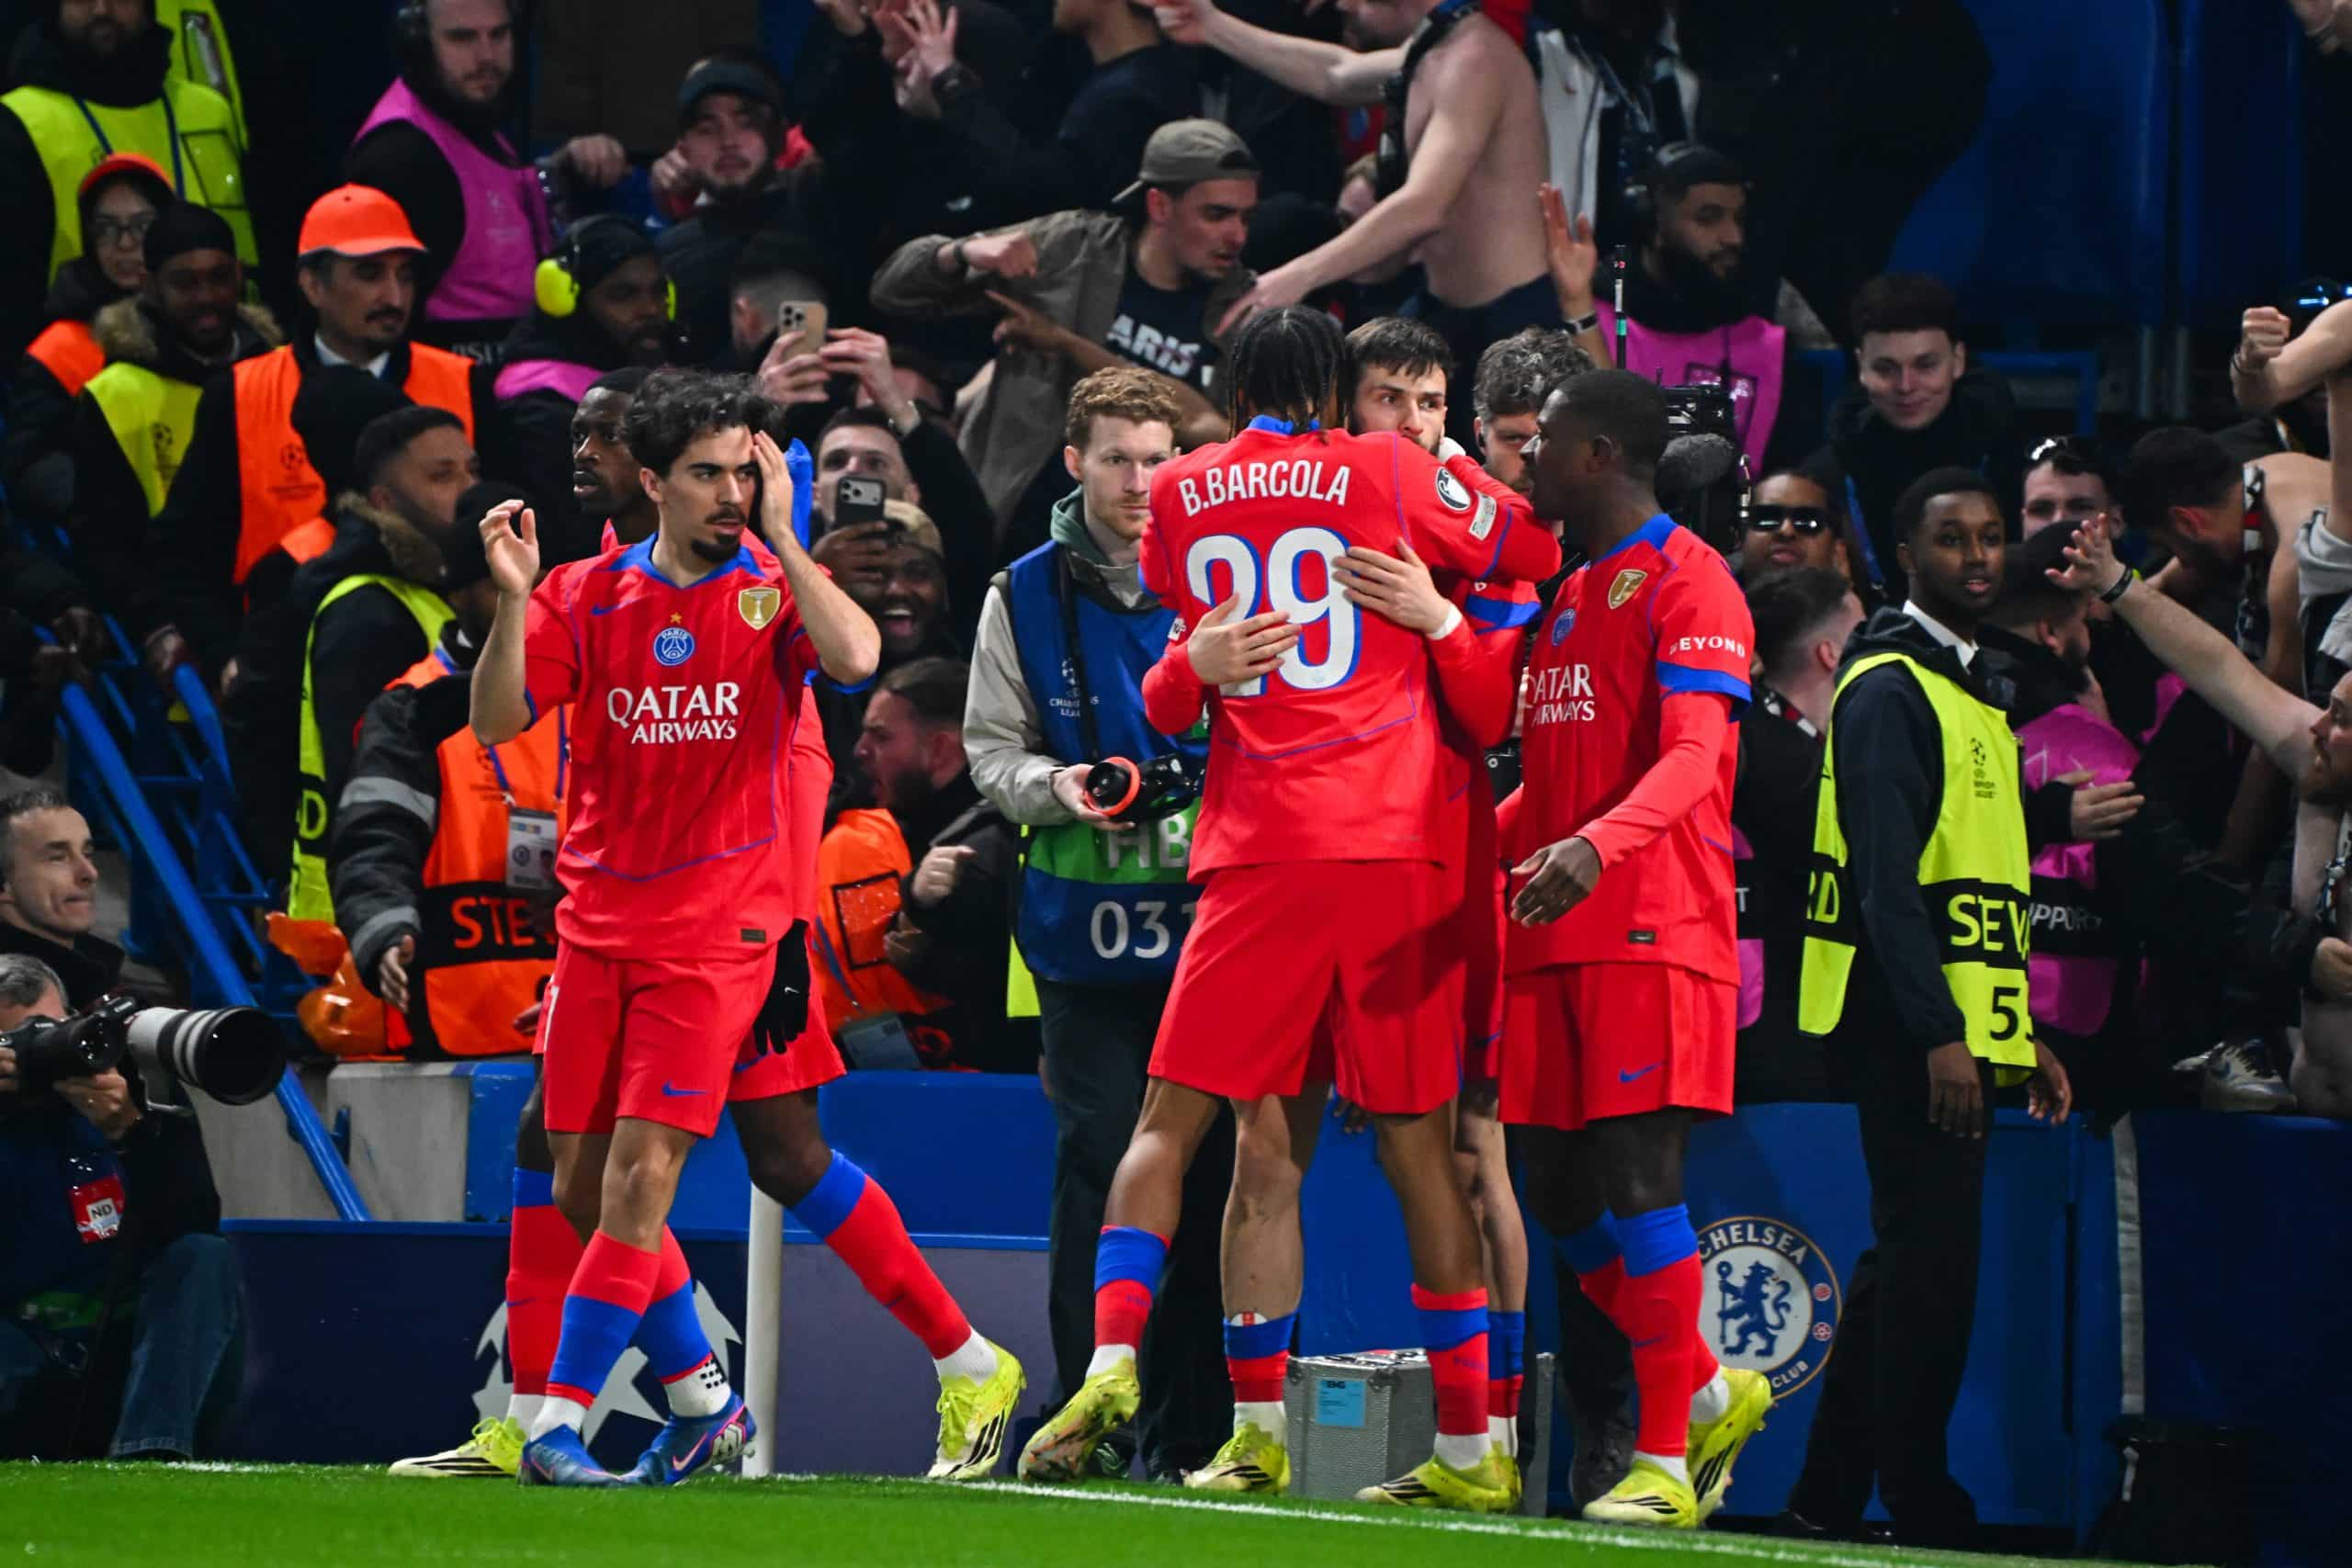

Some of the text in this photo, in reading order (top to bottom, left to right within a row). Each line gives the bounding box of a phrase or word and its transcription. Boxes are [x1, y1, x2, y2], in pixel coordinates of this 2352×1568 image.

[1178, 459, 1351, 517] B.BARCOLA
[1186, 526, 1362, 697] 29
[607, 682, 740, 728] QATAR
[631, 718, 737, 745] AIRWAYS
[91, 1203, 112, 1220] ND
[1698, 1224, 1809, 1265] CHELSEA
[1771, 1360, 1809, 1389] CLUB
